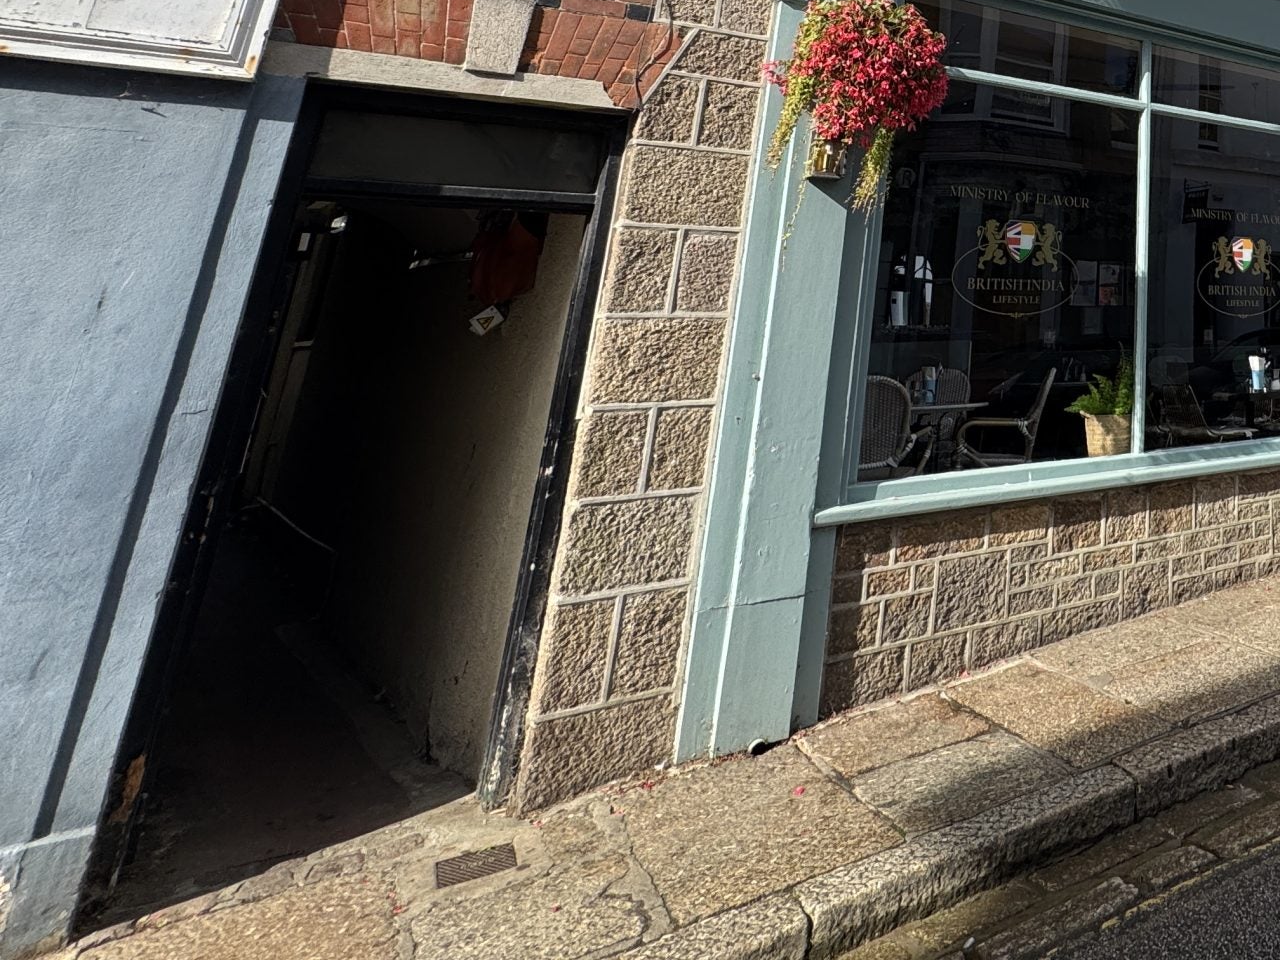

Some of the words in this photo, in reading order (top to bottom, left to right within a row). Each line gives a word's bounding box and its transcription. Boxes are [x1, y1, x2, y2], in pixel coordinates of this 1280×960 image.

[950, 184, 1009, 202] MINISTRY
[1015, 191, 1033, 204] OF
[1036, 192, 1090, 209] FLAVOUR
[1190, 207, 1233, 221] MINISTRY
[1236, 211, 1249, 223] OF
[967, 277, 1023, 291] BRITISH
[1027, 279, 1065, 292] INDIA
[1208, 285, 1247, 296] BRITISH
[1249, 285, 1276, 297] INDIA
[992, 295, 1040, 305] LIFESTYLE
[1226, 299, 1259, 307] LIFESTYLE
